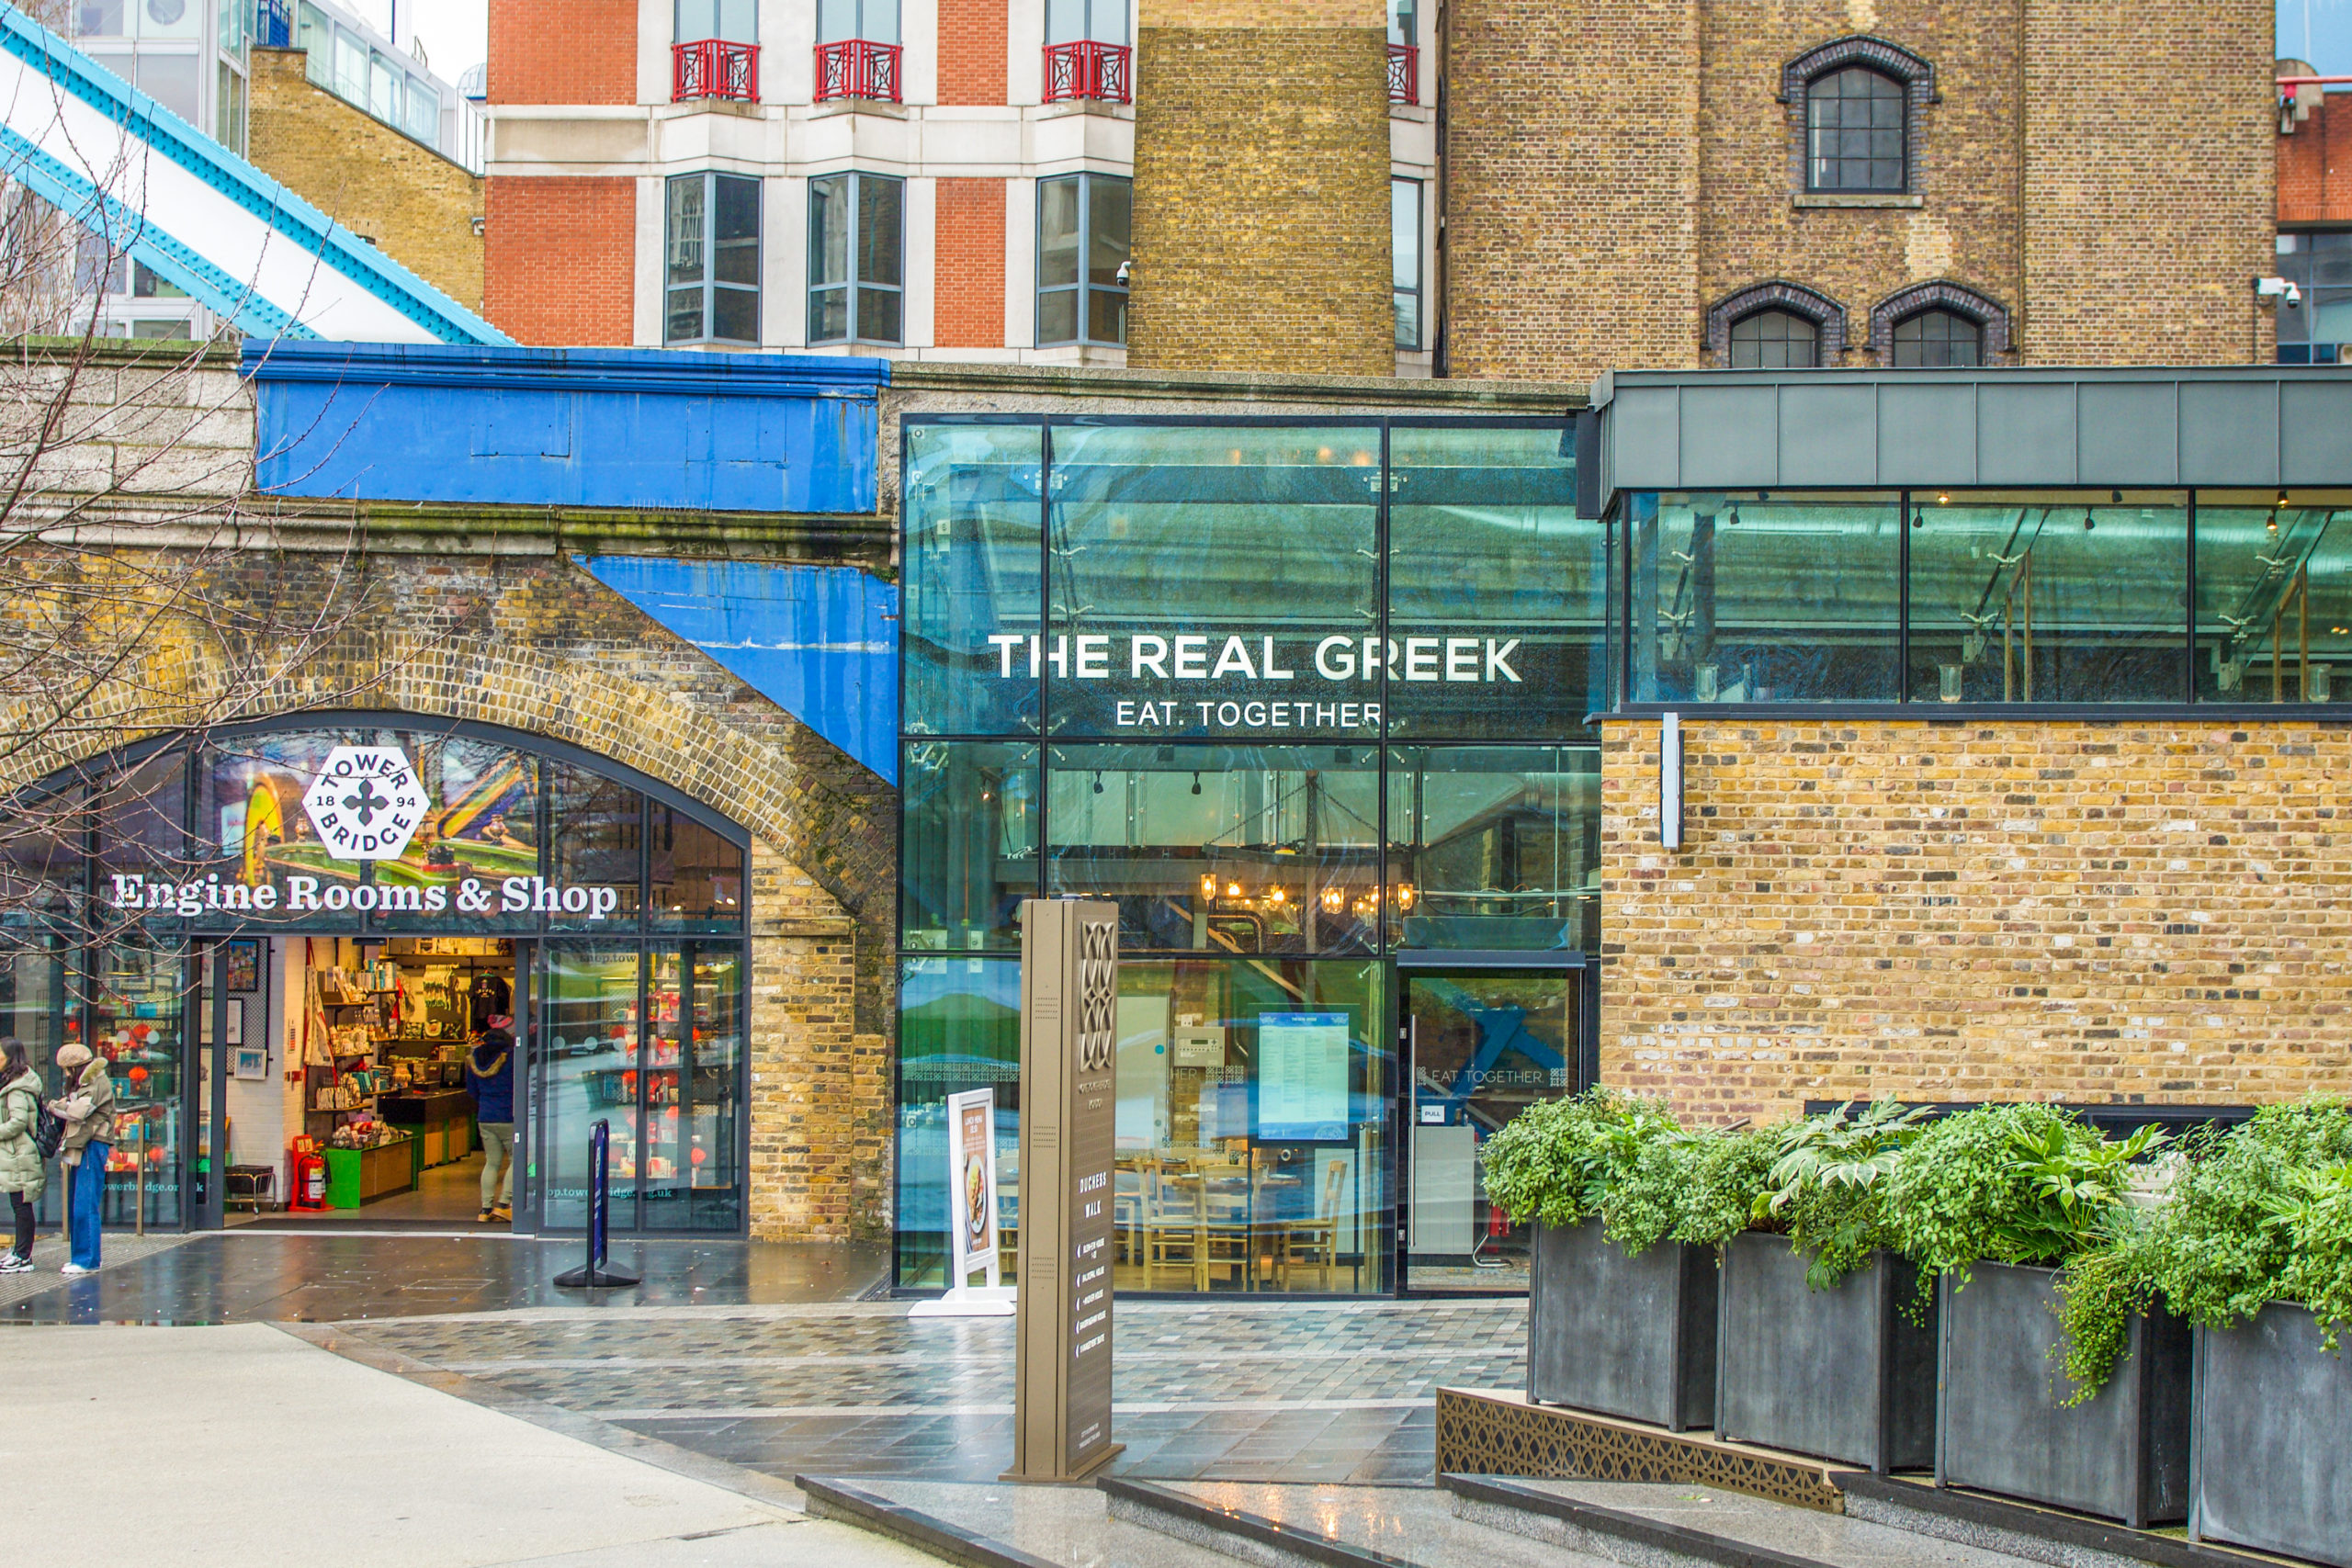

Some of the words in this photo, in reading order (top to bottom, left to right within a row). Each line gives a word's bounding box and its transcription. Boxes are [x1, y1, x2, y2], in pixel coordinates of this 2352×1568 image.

[988, 635, 1109, 678] THE
[1132, 635, 1294, 679] REAL
[1316, 635, 1522, 682] GREEK
[1116, 701, 1184, 726] EAT.
[321, 754, 408, 790] TOWER
[316, 795, 334, 807] 18
[396, 796, 415, 807] 94
[321, 812, 411, 852] BRIDGE
[110, 874, 277, 917] Engine
[287, 875, 447, 910] Rooms
[457, 878, 492, 911] &
[501, 876, 617, 919] Shop
[1431, 1070, 1460, 1083] EAT.
[1465, 1070, 1544, 1084] TOGETHER.
[1080, 1171, 1107, 1193] DUCHESS
[1085, 1200, 1102, 1218] WALK
